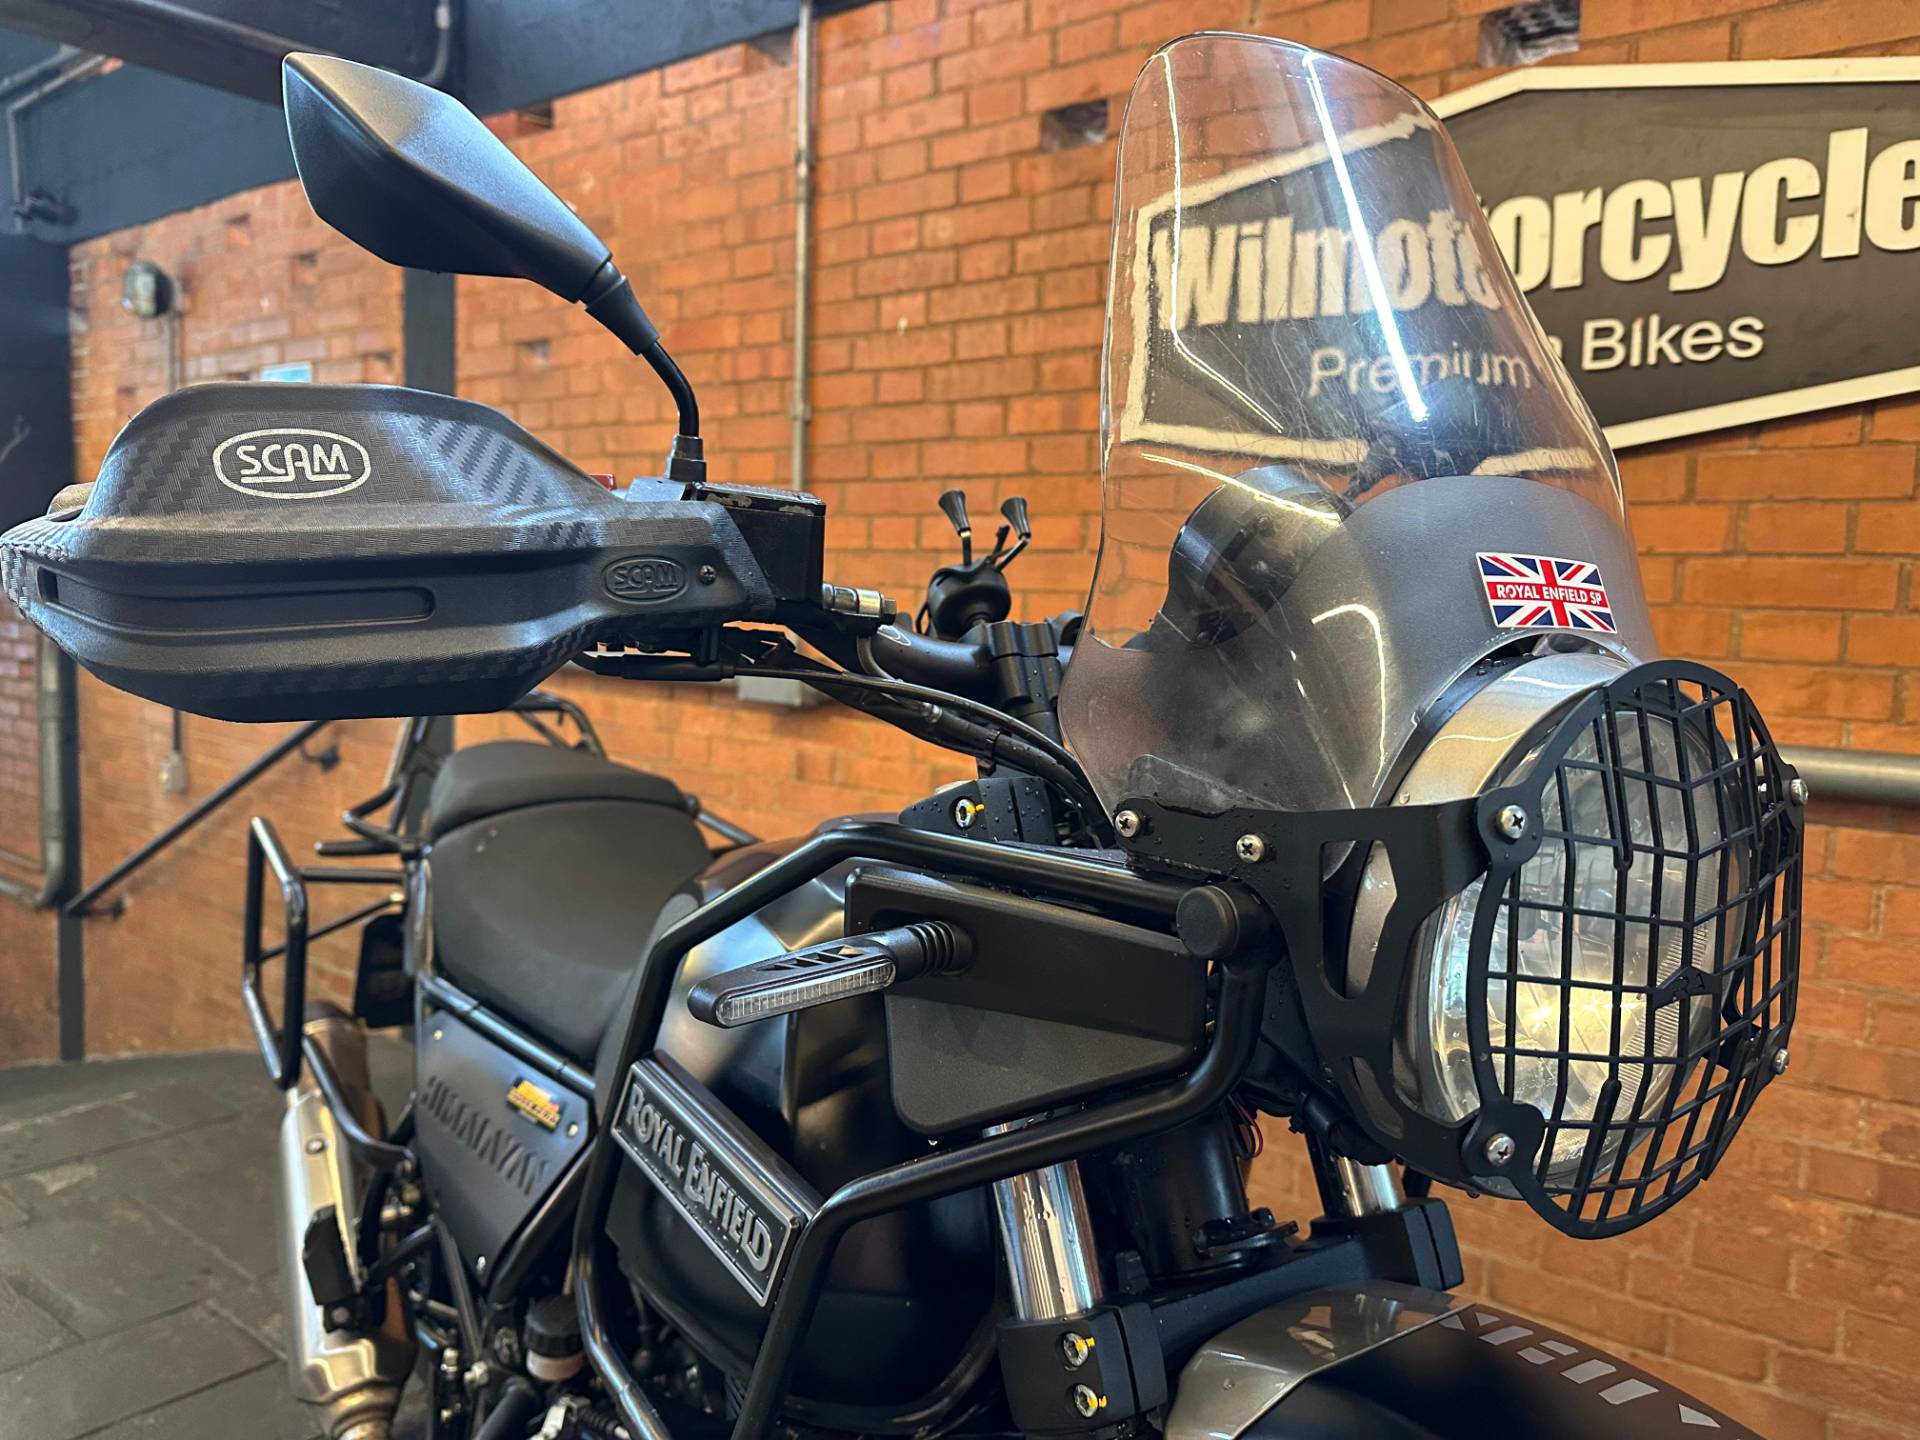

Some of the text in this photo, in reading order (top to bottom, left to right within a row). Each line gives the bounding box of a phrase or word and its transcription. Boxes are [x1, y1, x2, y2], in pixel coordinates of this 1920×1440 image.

[1307, 340, 1534, 398] Premium
[236, 443, 352, 484] SCAM
[612, 564, 680, 595] SCAM
[1496, 584, 1541, 600] ROYAL
[1542, 586, 1588, 603] ENFIELD
[626, 1083, 773, 1272] ROYAL ENFIELD
